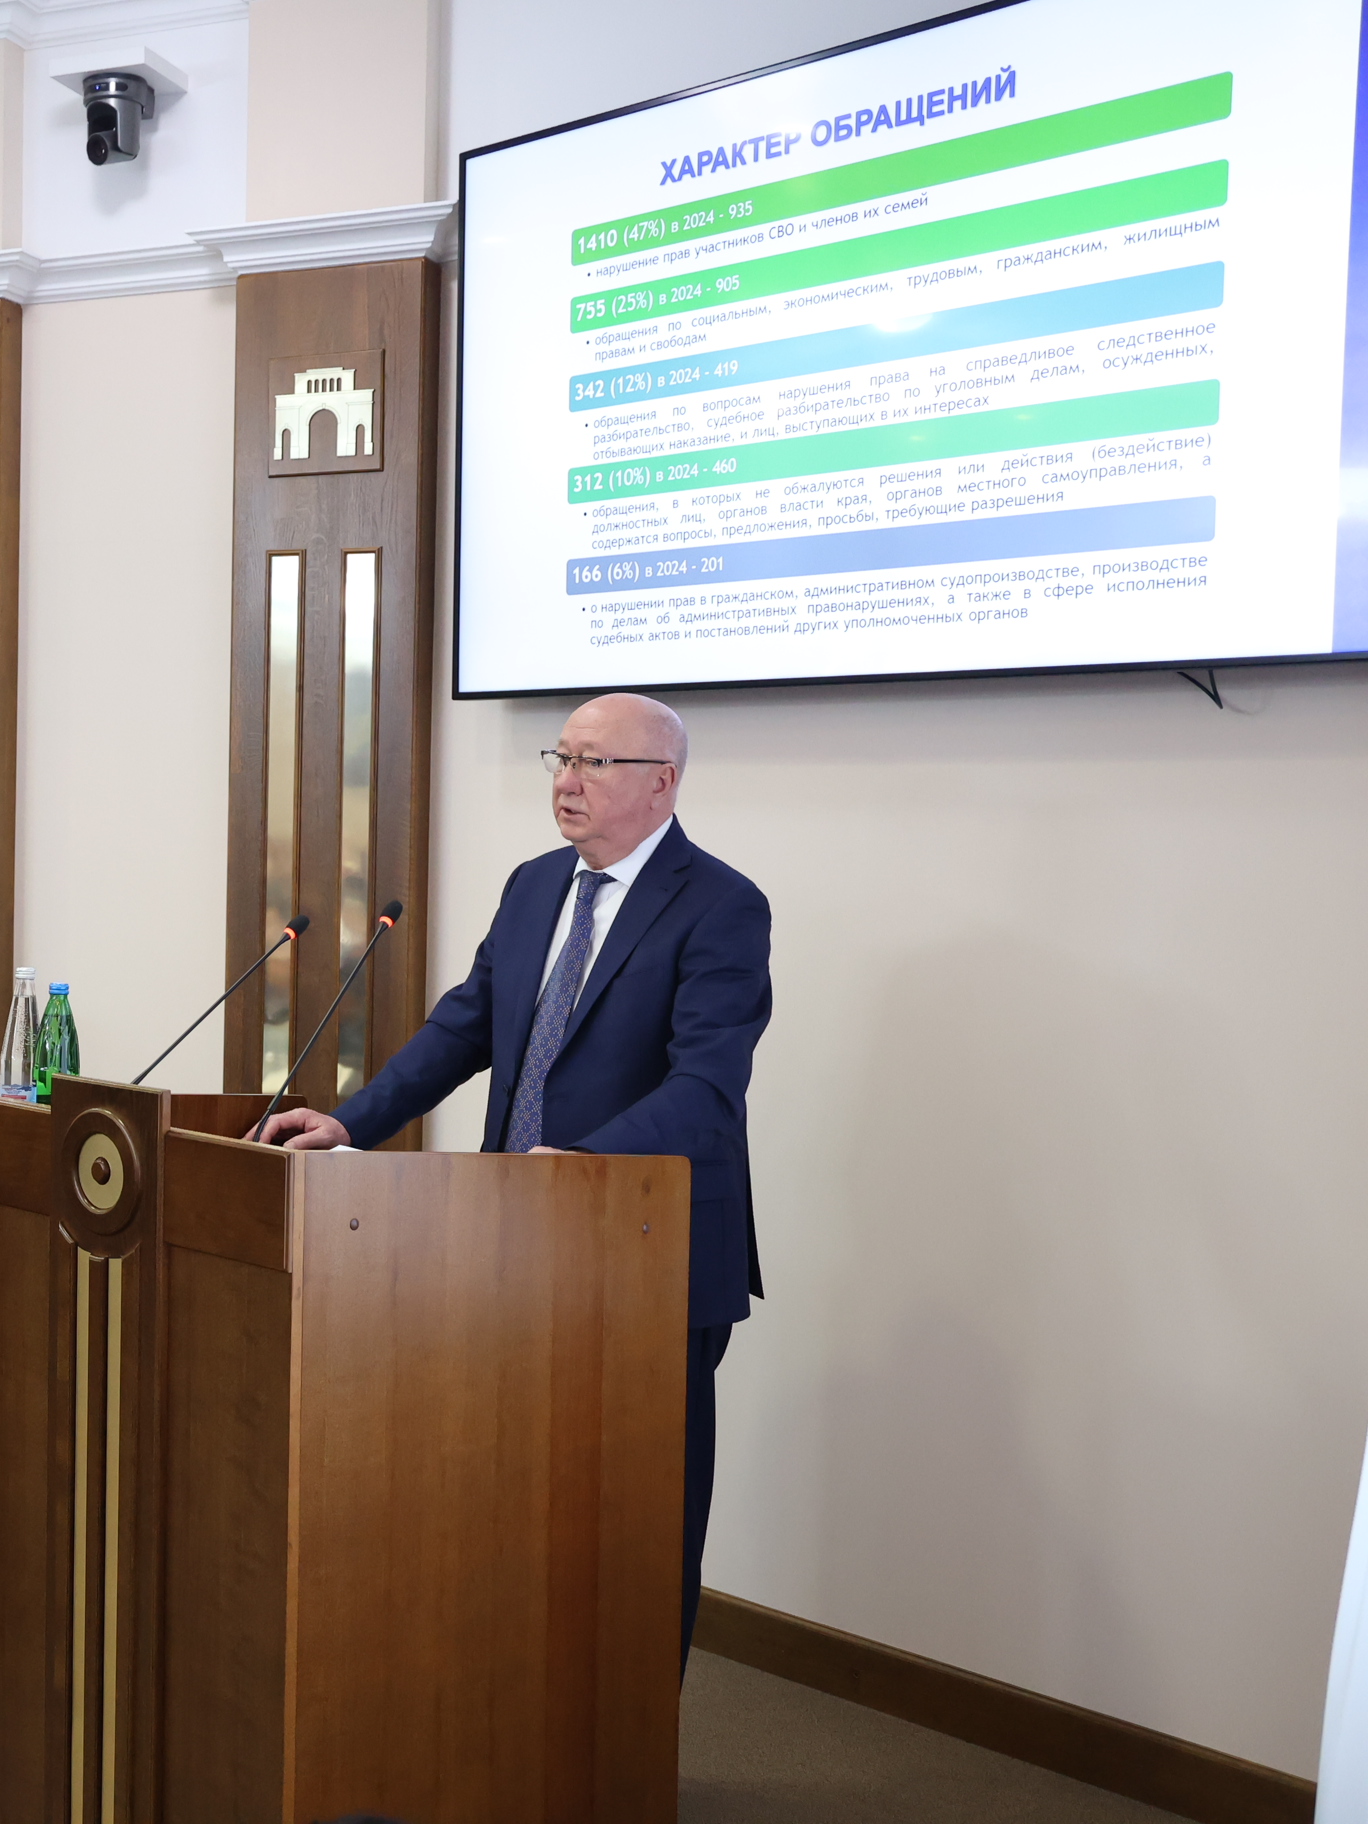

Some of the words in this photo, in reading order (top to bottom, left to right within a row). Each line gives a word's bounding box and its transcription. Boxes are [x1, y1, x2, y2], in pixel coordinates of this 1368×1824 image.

[659, 132, 801, 186] ХАРАКТЕР
[810, 64, 1017, 147] ОБРАЩЕНИЙ
[578, 228, 618, 253] 1410
[623, 218, 666, 247] (47%)
[671, 221, 679, 233] в
[682, 209, 715, 230] 2024
[728, 199, 754, 219] 935
[596, 255, 659, 277] нарушение
[663, 248, 690, 264] прав
[694, 232, 764, 259] участников
[768, 222, 794, 240] СВО
[798, 223, 806, 233] и
[811, 211, 858, 230] членов
[863, 206, 879, 219] их
[884, 191, 928, 214] семей
[575, 298, 606, 321] 755
[611, 290, 654, 318] (25%)
[658, 293, 667, 305] в
[670, 282, 702, 303] 2024
[715, 274, 740, 293] 905
[594, 325, 658, 346] обращения
[667, 320, 682, 332] по
[691, 305, 771, 327] социальным,
[783, 281, 893, 310] экономическим,
[906, 264, 982, 289] трудовым,
[996, 240, 1107, 272] гражданским,
[1123, 217, 1220, 245] жилищным
[593, 410, 656, 429] обращения
[672, 405, 686, 416] по
[702, 395, 761, 412] вопросам
[778, 380, 851, 401] нарушения
[869, 371, 909, 388] права
[929, 365, 945, 377] на
[966, 345, 1074, 372] справедливое
[1097, 322, 1216, 351] следственное
[594, 346, 635, 363] правам
[639, 344, 646, 352] и
[649, 333, 706, 351] свободам
[574, 379, 605, 401] 342
[610, 371, 652, 398] (12%)
[657, 375, 665, 387] в
[669, 366, 700, 385] 2024
[713, 359, 738, 377] 419
[593, 421, 694, 447] разбирательство,
[706, 410, 764, 430] судебное
[777, 391, 890, 420] разбирательство
[904, 387, 920, 398] по
[934, 373, 1015, 397] уголовным
[1030, 363, 1085, 383] делам,
[1102, 343, 1213, 370] осужденных,
[592, 442, 664, 460] отбывающих
[669, 432, 734, 449] наказание,
[740, 431, 747, 439] и
[752, 426, 779, 438] лиц,
[784, 412, 875, 434] выступающих
[880, 410, 888, 420] в
[893, 407, 908, 417] их
[914, 395, 989, 415] интересах
[573, 472, 604, 492] 312
[608, 466, 651, 492] (10%)
[655, 470, 664, 482] в
[667, 462, 699, 480] 2024
[711, 457, 737, 474] 460
[591, 501, 659, 519] обращения,
[672, 499, 679, 509] в
[691, 491, 741, 506] которых
[755, 488, 770, 498] не
[783, 476, 864, 495] обжалуются
[879, 467, 941, 488] решения
[958, 463, 984, 475] или
[1000, 452, 1073, 473] действия
[1091, 432, 1211, 462] (бездействие)
[591, 516, 668, 536] должностных
[679, 512, 705, 524] лиц,
[718, 505, 767, 522] органов
[780, 499, 823, 513] власти
[836, 493, 872, 509] края,
[886, 485, 942, 504] органов
[956, 476, 1026, 493] местного
[1041, 458, 1183, 484] самоуправления,
[1202, 455, 1211, 466] а
[591, 533, 658, 551] содержатся
[662, 528, 716, 543] вопросы,
[721, 518, 811, 539] предложения,
[817, 508, 879, 529] просьбы,
[884, 501, 965, 522] требующие
[971, 491, 1064, 514] разрешения
[573, 564, 601, 583] 166
[607, 561, 639, 584] (6%)
[645, 566, 652, 577] в
[656, 559, 687, 576] 2024
[700, 556, 723, 572] 201
[590, 604, 597, 613] о
[600, 599, 664, 614] нарушении
[668, 596, 696, 610] прав
[700, 595, 706, 605] в
[710, 589, 798, 607] гражданском,
[803, 578, 935, 599] административном
[940, 566, 1084, 590] судопроизводстве,
[1092, 555, 1208, 578] производстве
[589, 631, 644, 647] судебных
[647, 630, 680, 641] актов
[684, 630, 691, 638] и
[695, 619, 789, 638] постановлений
[793, 620, 839, 635] других
[843, 611, 963, 632] уполномоченных
[968, 607, 1028, 624] органов
[590, 619, 604, 628] по
[611, 616, 647, 631] делам
[655, 611, 670, 624] об
[678, 605, 796, 625] административных
[807, 595, 934, 616] правонарушениях,
[947, 594, 955, 604] а
[966, 589, 1011, 603] также
[1023, 588, 1031, 599] в
[1043, 582, 1094, 600] сфере
[1106, 575, 1207, 592] исполнения
